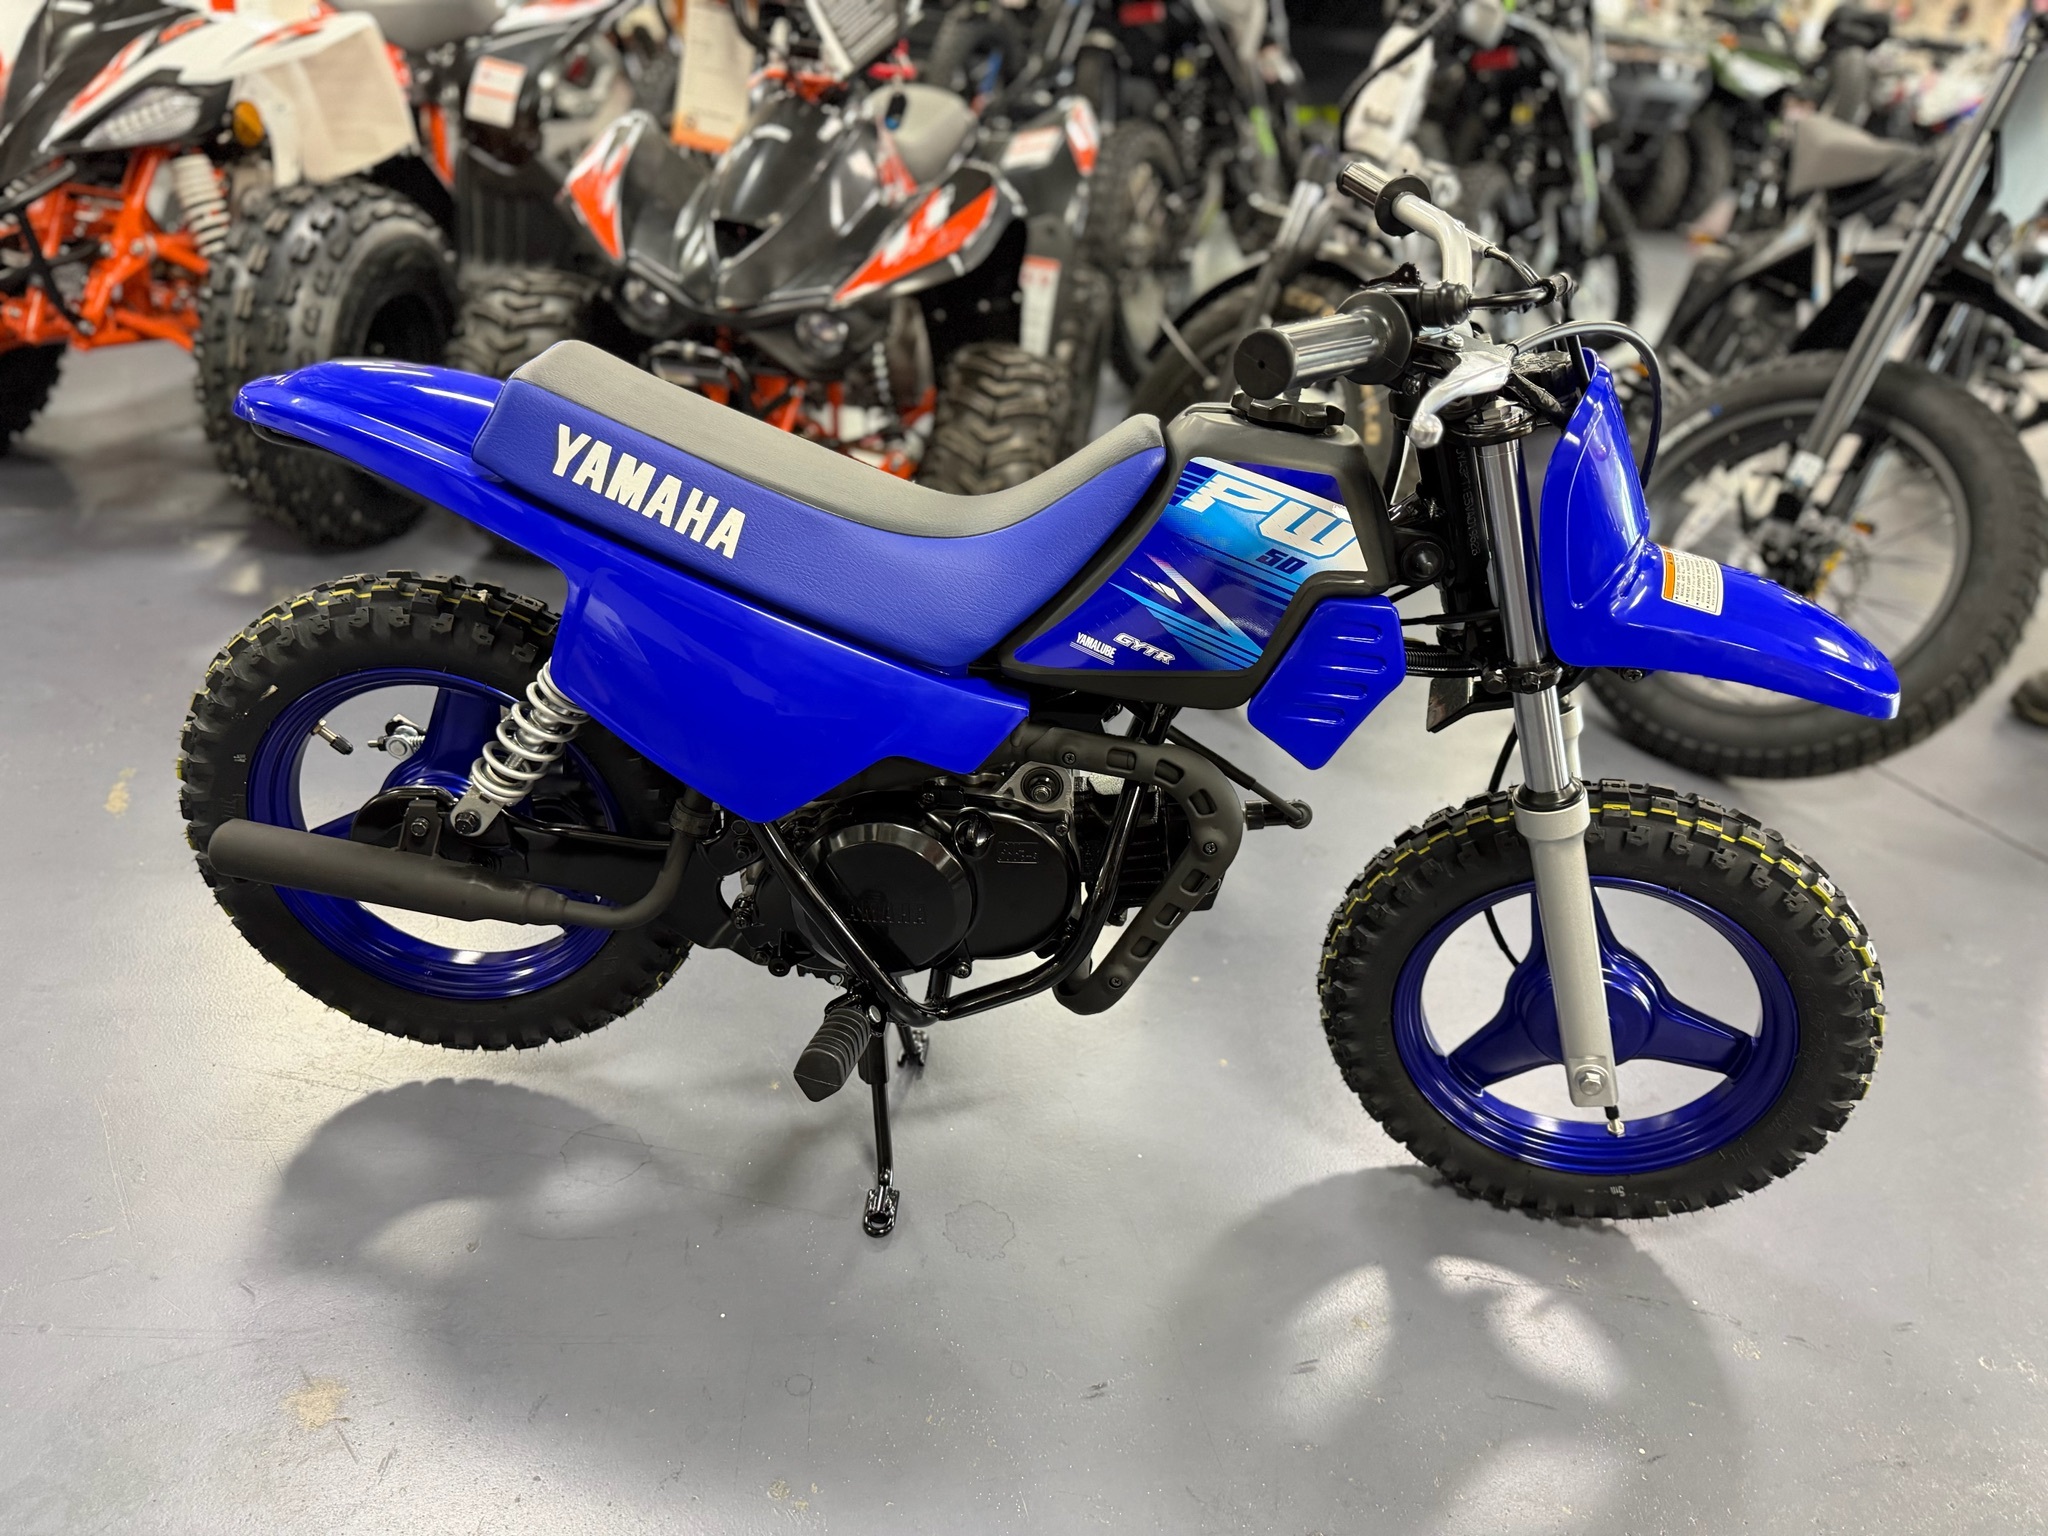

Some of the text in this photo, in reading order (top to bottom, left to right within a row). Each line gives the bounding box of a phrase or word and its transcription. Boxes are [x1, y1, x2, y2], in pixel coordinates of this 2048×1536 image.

[552, 423, 746, 559] YAMAHA
[1179, 473, 1358, 557] PW
[1255, 548, 1308, 575] 50
[1076, 631, 1117, 659] YAMALUBE
[1113, 632, 1176, 665] GYTR
